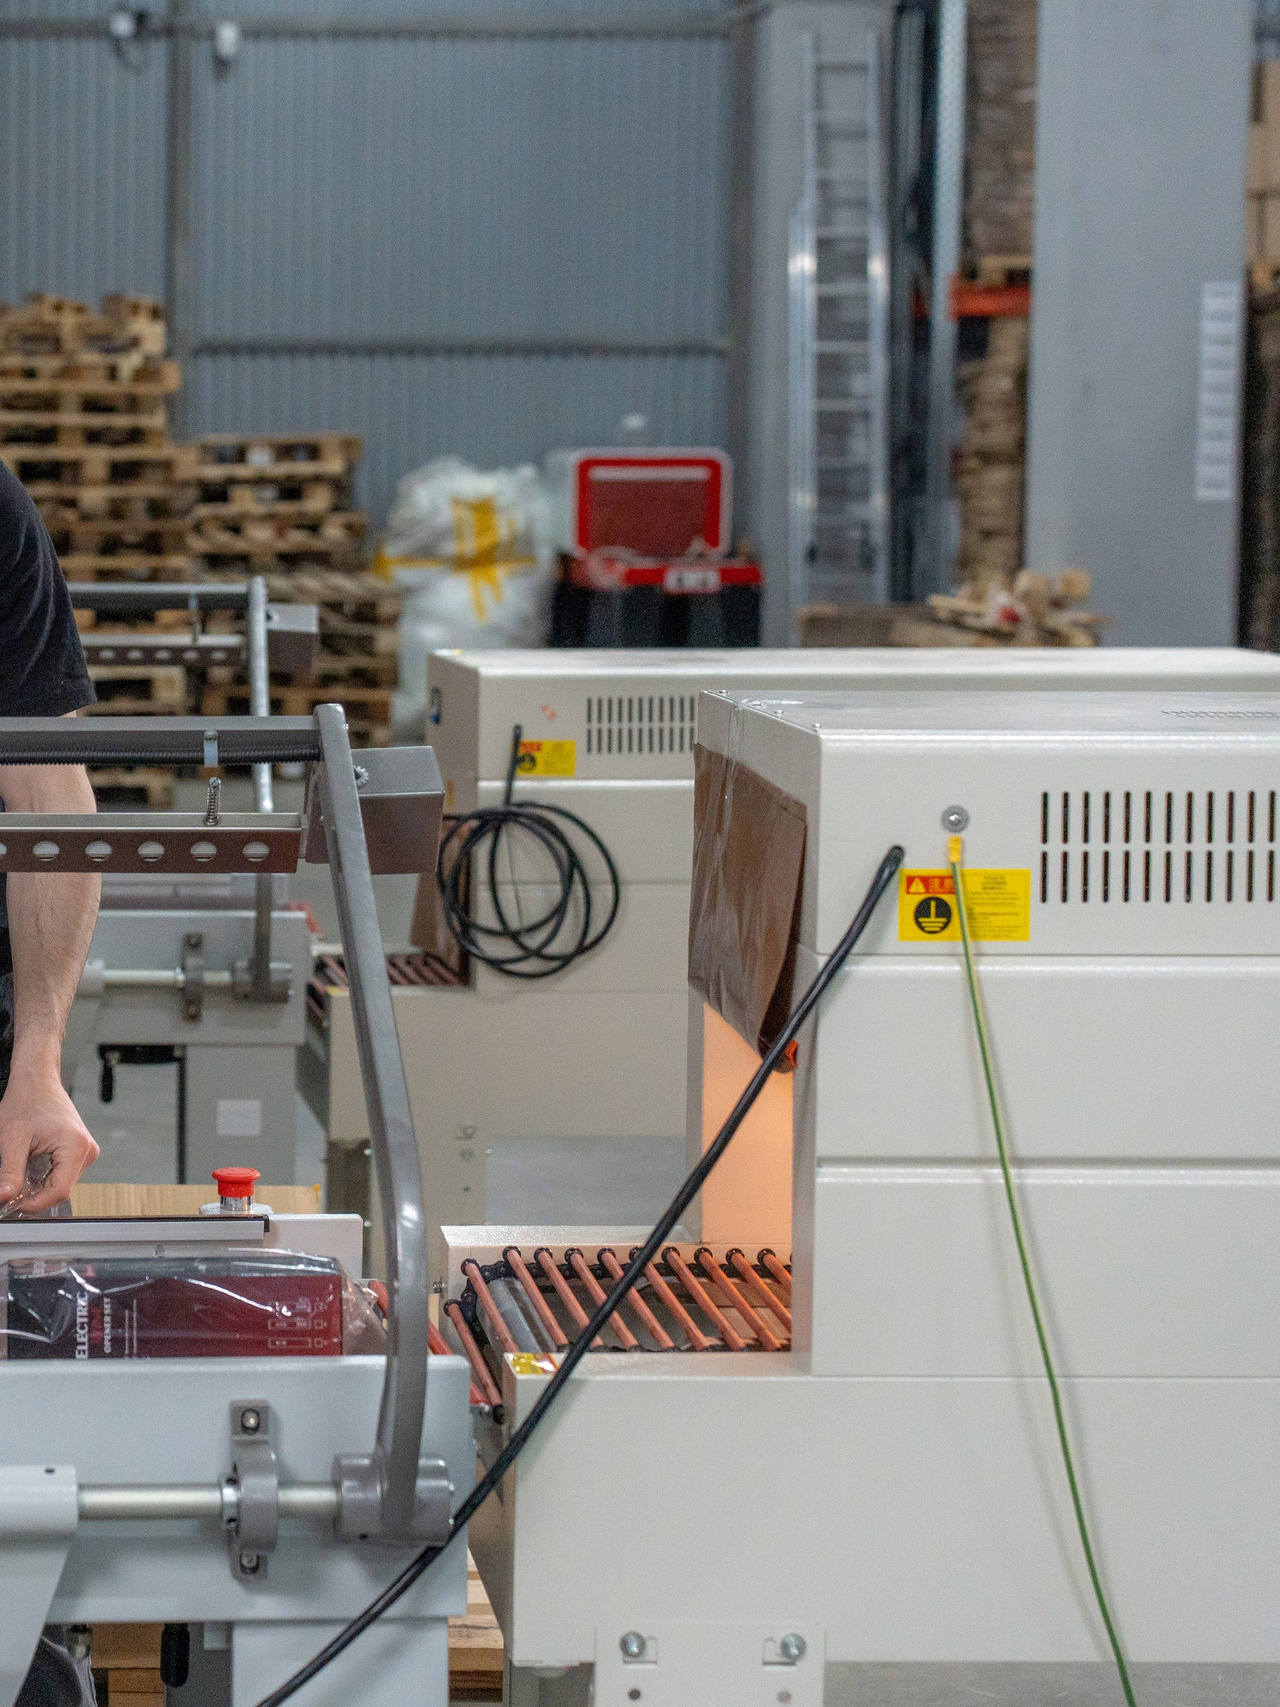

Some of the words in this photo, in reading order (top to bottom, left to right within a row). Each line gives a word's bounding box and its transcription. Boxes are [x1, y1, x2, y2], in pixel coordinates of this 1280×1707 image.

[76, 1291, 88, 1359] ELECTRIC
[103, 1297, 111, 1315] SET
[103, 1315, 111, 1353] OPENER
